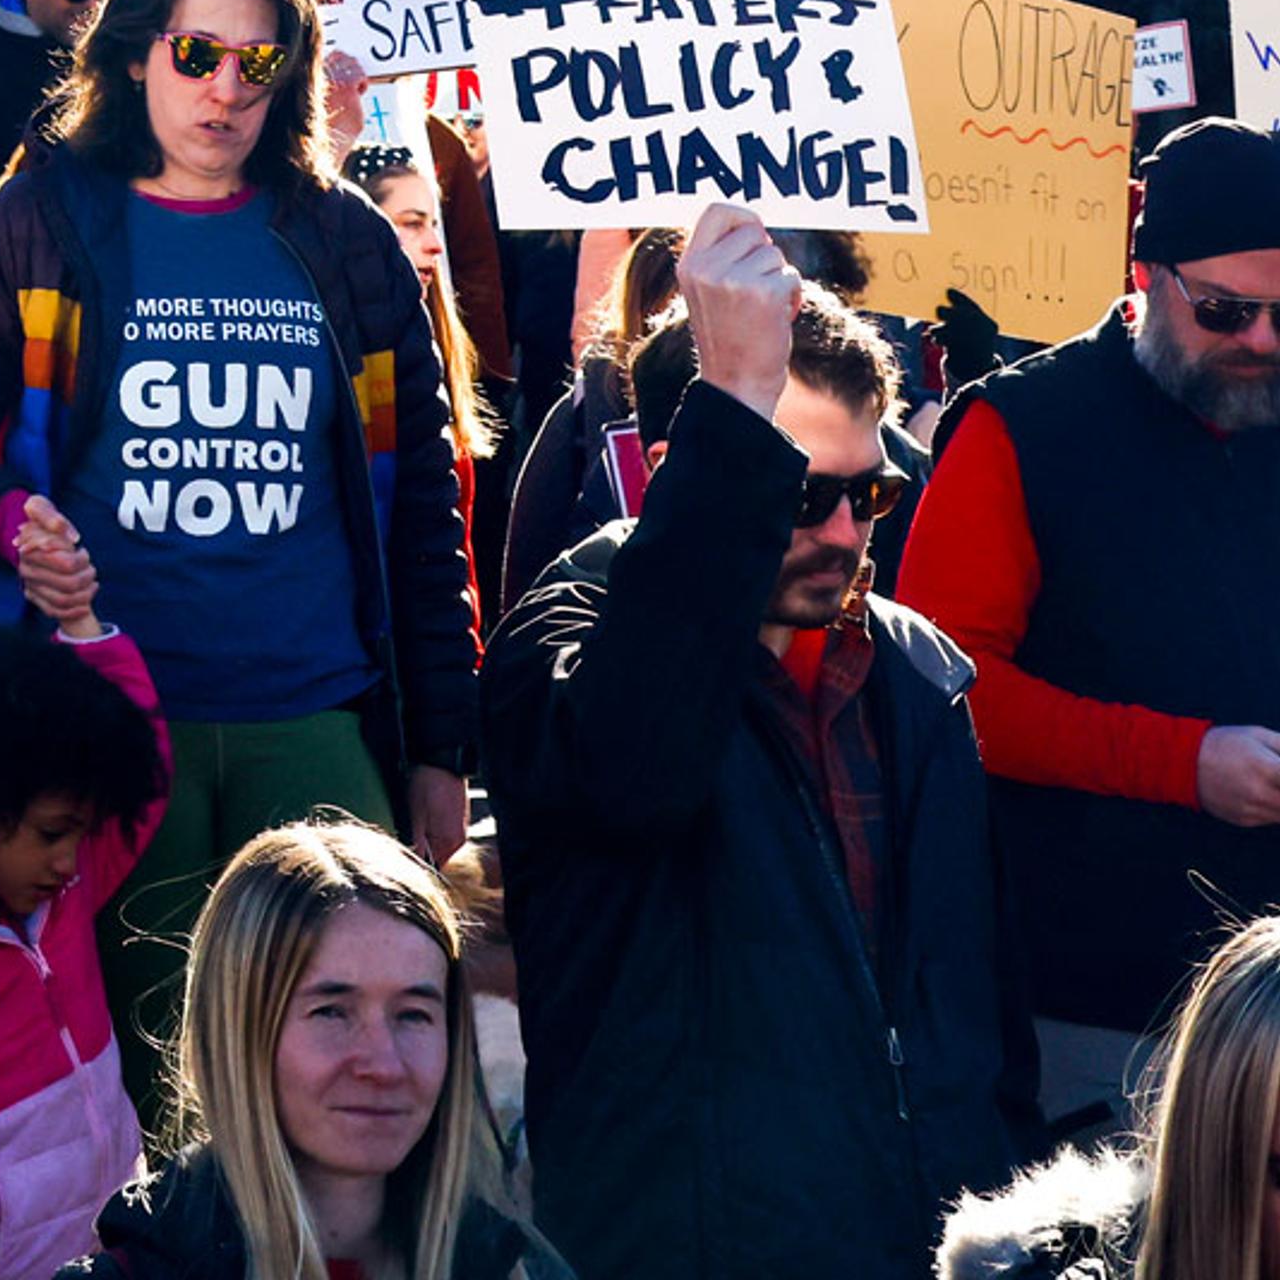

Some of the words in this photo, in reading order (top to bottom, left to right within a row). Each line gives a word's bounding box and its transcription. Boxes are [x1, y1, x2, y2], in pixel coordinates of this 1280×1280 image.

[511, 37, 801, 123] POLICY
[541, 127, 918, 222] CHANGE!
[1031, 171, 1058, 215] fit
[1076, 197, 1107, 221] on
[893, 248, 919, 282] a
[136, 298, 206, 317] MORE
[210, 299, 323, 322] THOUGHTS
[146, 322, 216, 341] MORE
[222, 324, 320, 347] PRAYERS
[119, 360, 312, 432] GUN
[121, 438, 304, 473] CONTROL
[117, 478, 304, 537] NOW
